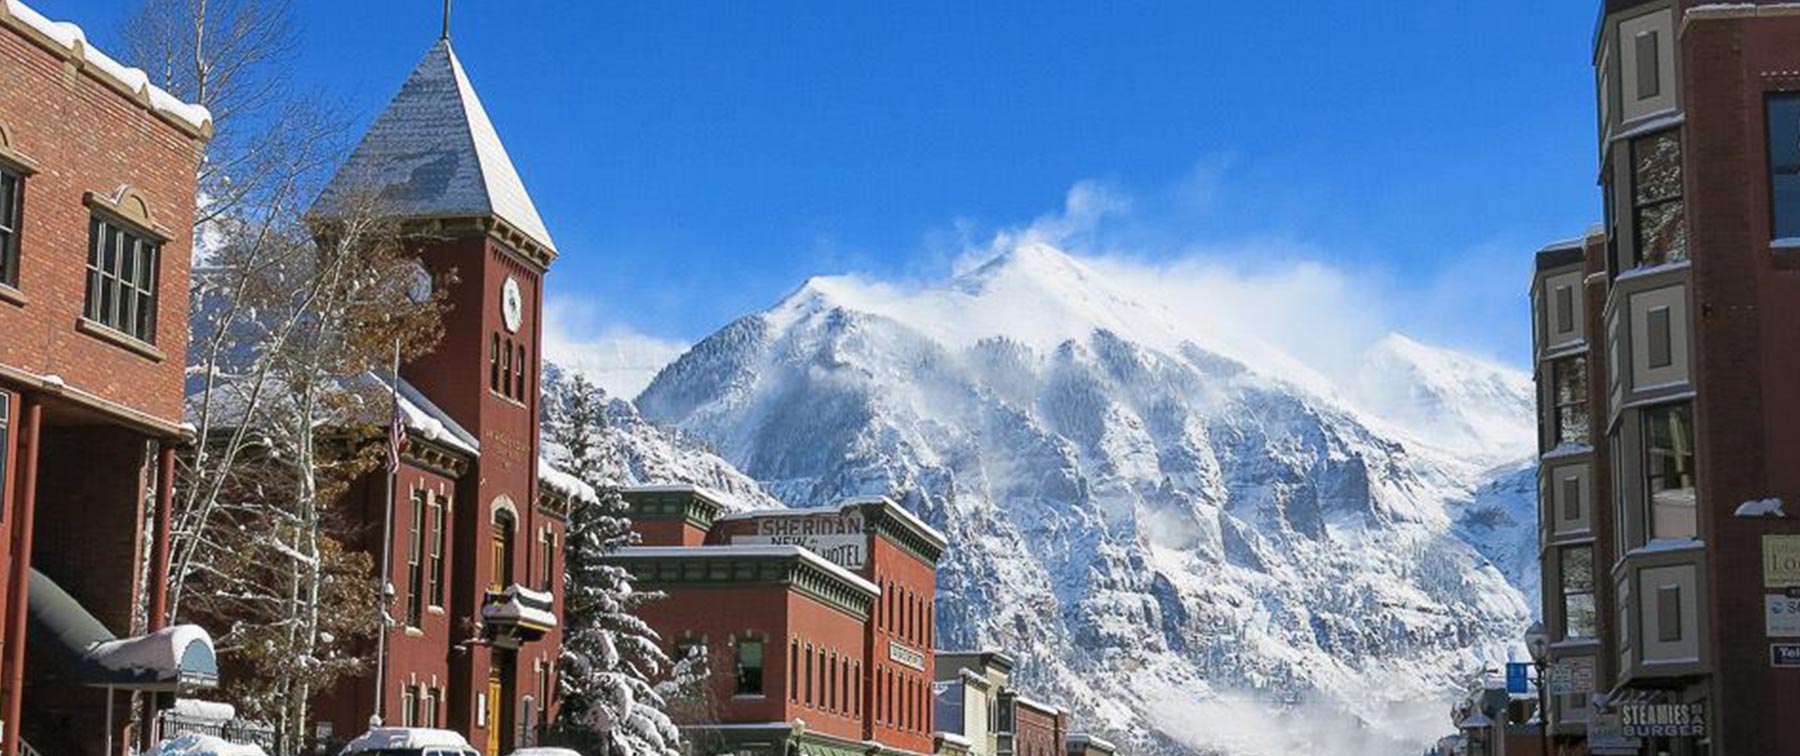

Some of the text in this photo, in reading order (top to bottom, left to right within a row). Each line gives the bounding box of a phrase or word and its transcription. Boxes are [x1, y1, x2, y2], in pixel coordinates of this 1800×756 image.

[761, 517, 861, 536] SHERIDAN
[771, 536, 807, 546] NEW
[822, 545, 862, 566] HOTEL
[1623, 703, 1690, 725] STEAMIES
[1623, 725, 1705, 737] BURGER
